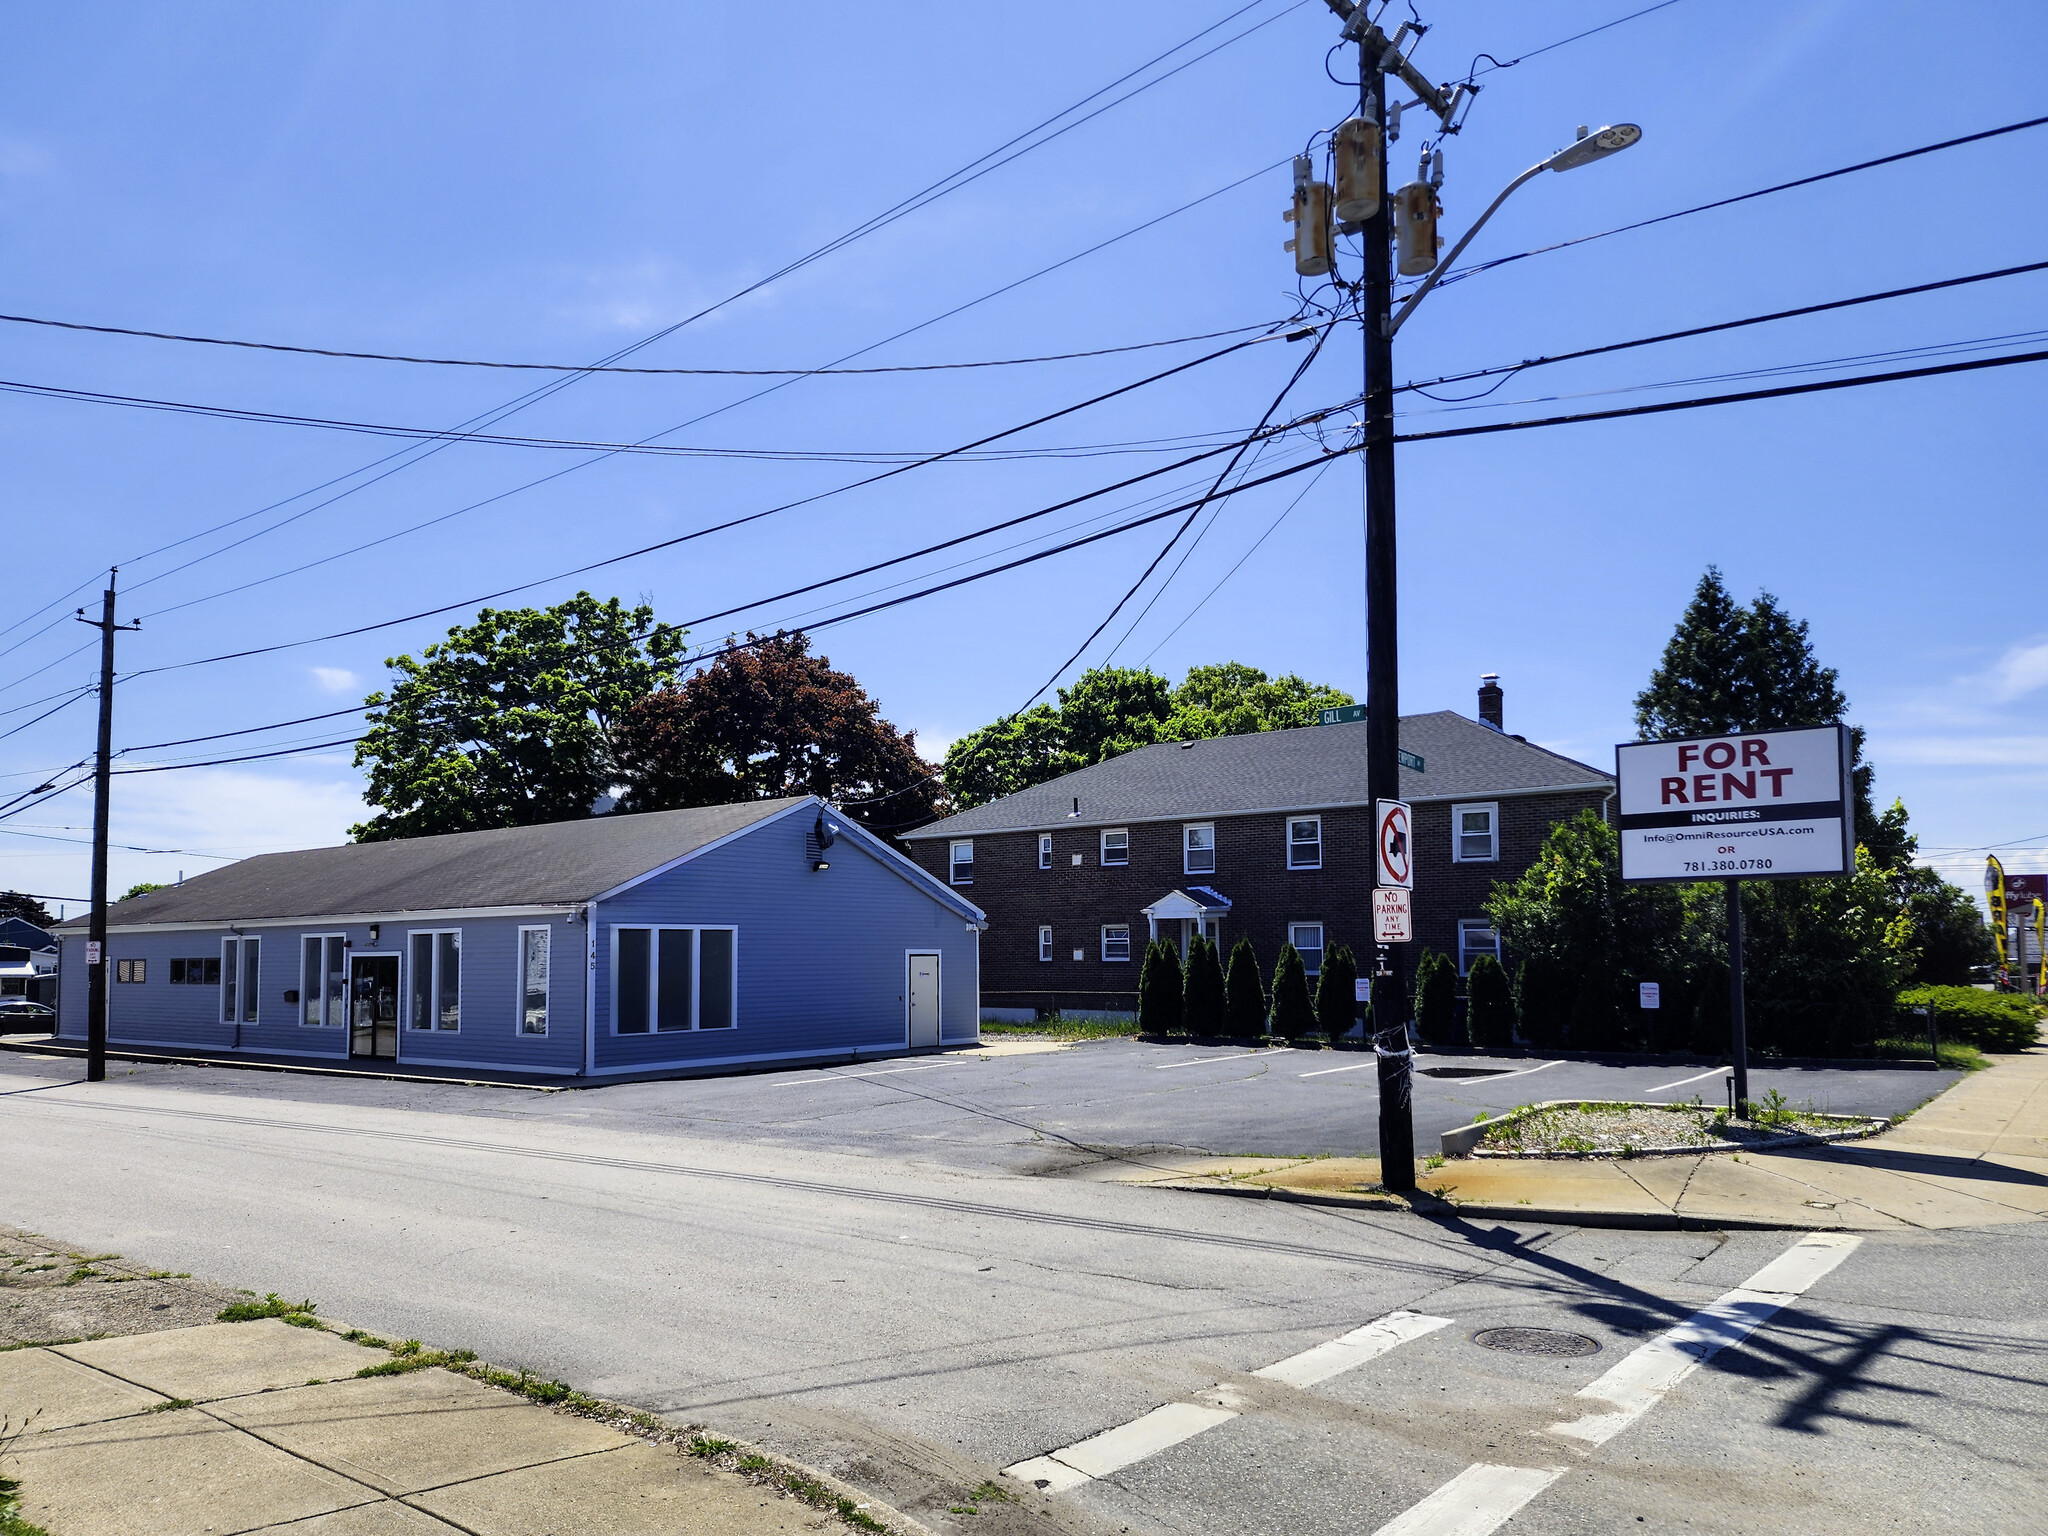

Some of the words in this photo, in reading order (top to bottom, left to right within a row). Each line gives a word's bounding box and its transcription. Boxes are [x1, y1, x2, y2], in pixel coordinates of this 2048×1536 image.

[1324, 710, 1341, 724] GILL
[1353, 710, 1361, 718] AV
[1678, 738, 1771, 773] FOR
[1660, 767, 1794, 805] RENT
[1691, 810, 1761, 822] INQUIRIES:
[1643, 826, 1815, 843] Info@OmniResourceUSA.com
[1717, 846, 1736, 854] OR
[1683, 859, 1773, 872] 781.380.0780
[1384, 893, 1398, 902] NO
[1376, 904, 1407, 914] PARKING
